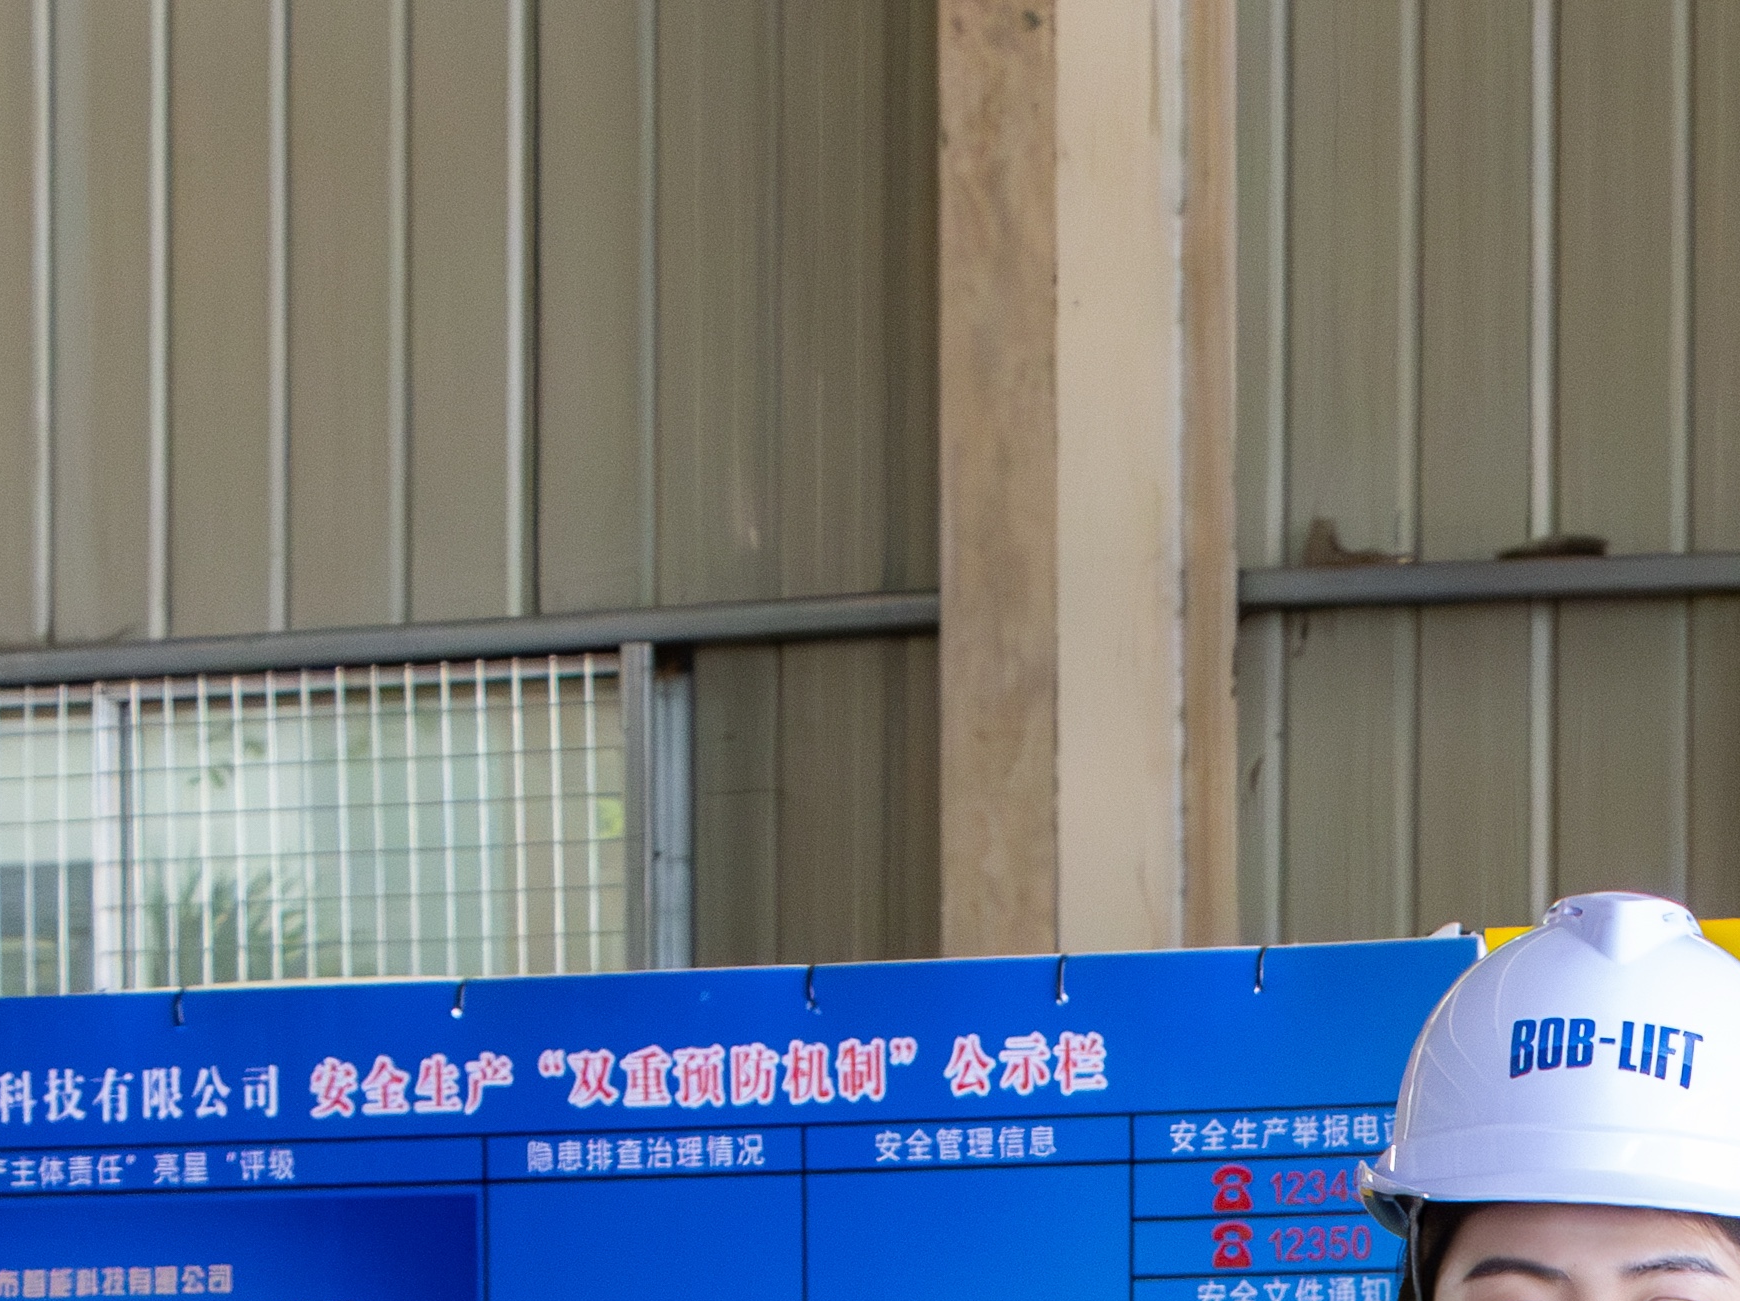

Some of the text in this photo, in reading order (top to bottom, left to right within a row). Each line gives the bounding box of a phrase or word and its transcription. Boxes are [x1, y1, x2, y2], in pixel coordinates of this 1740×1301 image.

[1509, 1016, 1704, 1090] BOB-LIFT
[526, 1133, 766, 1173] 隐患排查治理情况
[874, 1126, 1058, 1163] 安全管理信息
[1268, 1225, 1372, 1263] 12350
